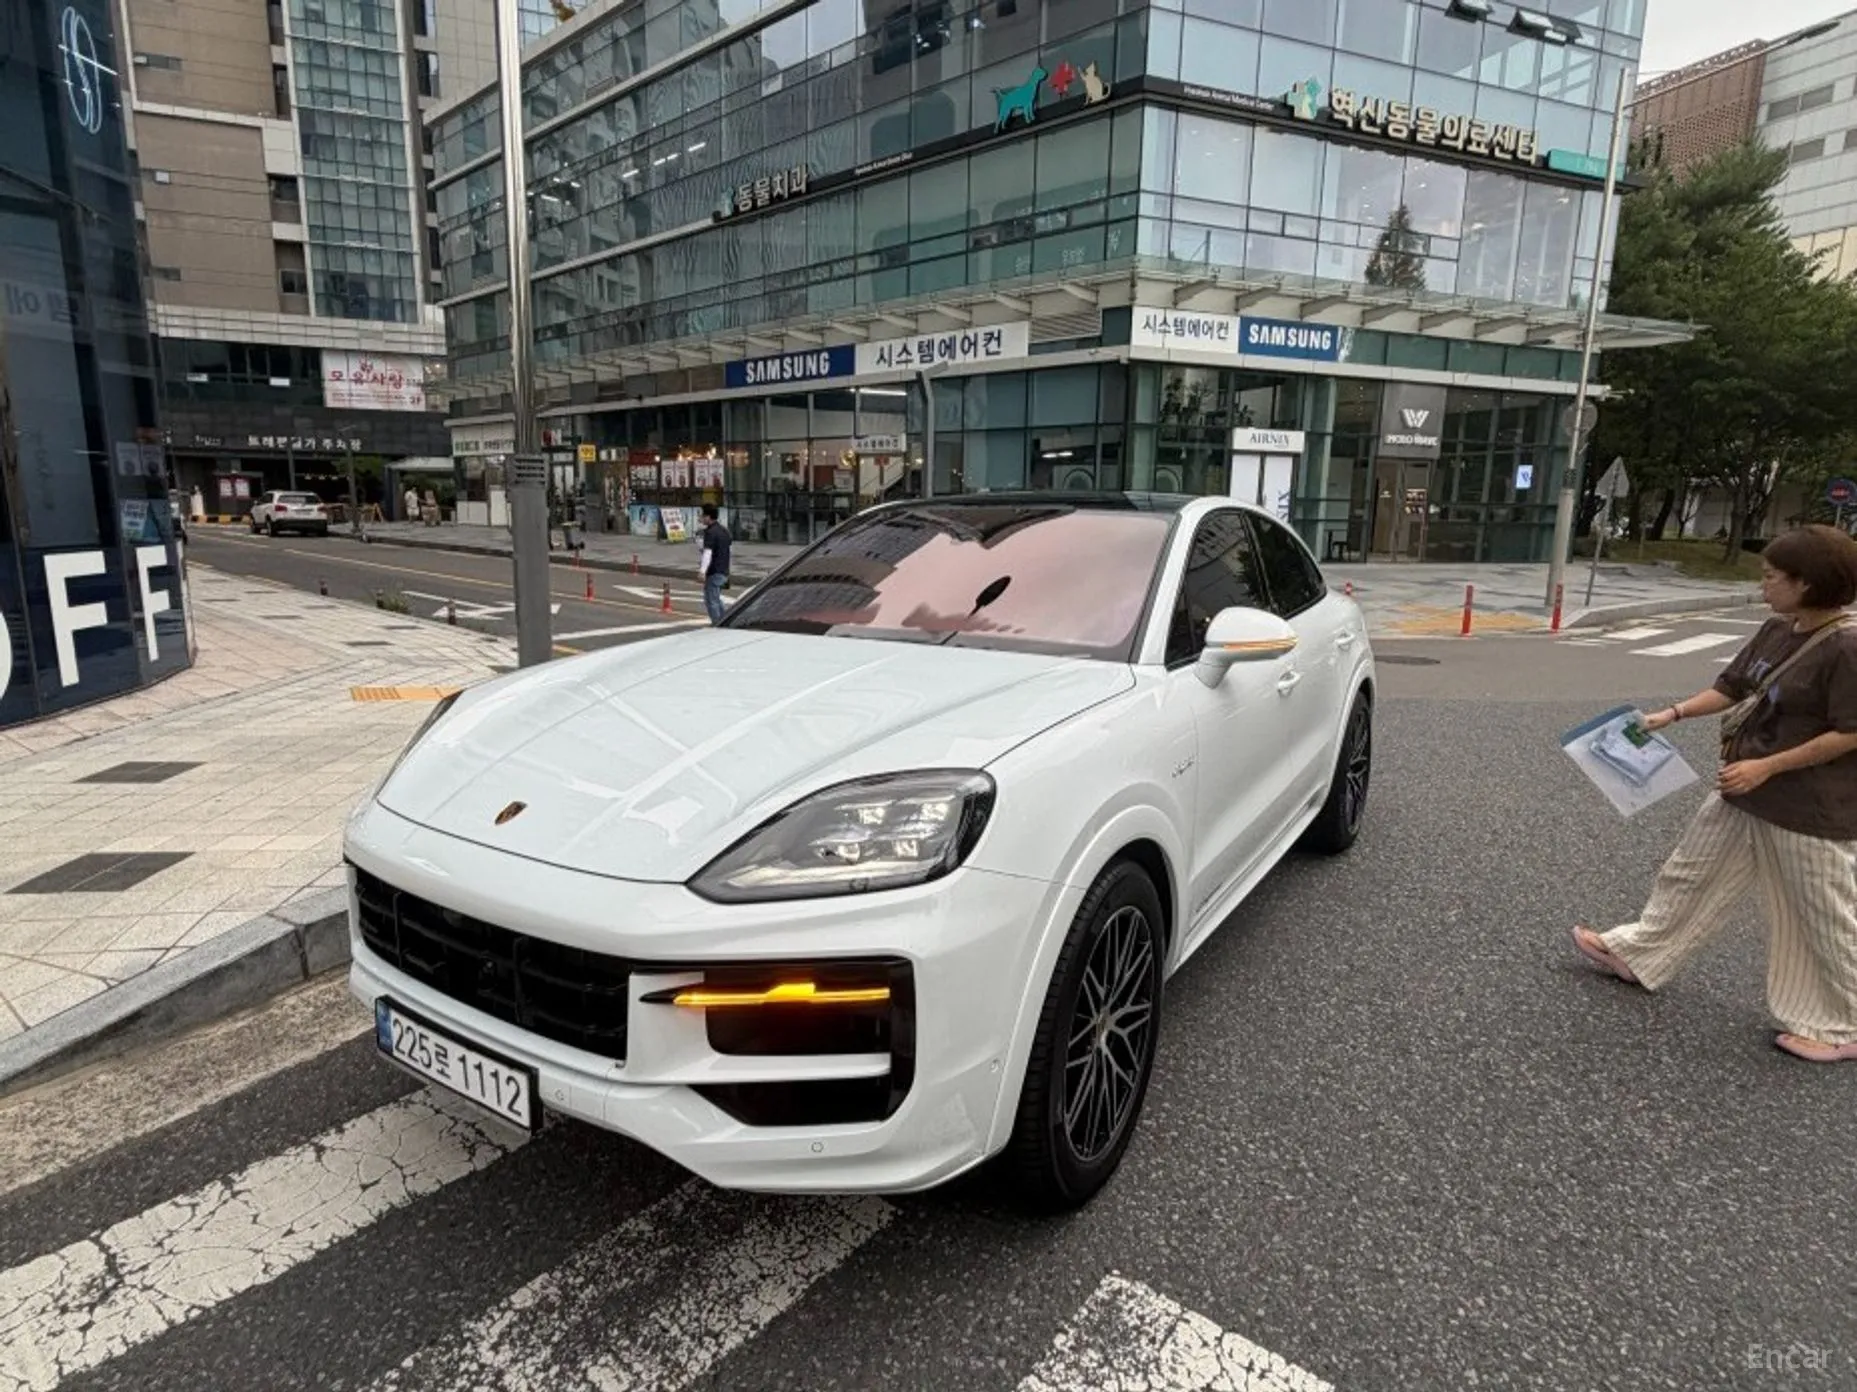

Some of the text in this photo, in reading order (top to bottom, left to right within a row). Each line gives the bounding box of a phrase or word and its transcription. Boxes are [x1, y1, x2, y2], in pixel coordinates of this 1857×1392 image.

[1330, 87, 1539, 166] 혁신동물의료센터
[737, 163, 809, 212] 동물치과
[1141, 313, 1230, 341] 시스템에어컨
[1247, 323, 1332, 350] SAMSUNG
[875, 328, 1003, 367] 시스템에어컨
[745, 351, 831, 384] SAMSUNG
[393, 1017, 522, 1118] 225로 1112
